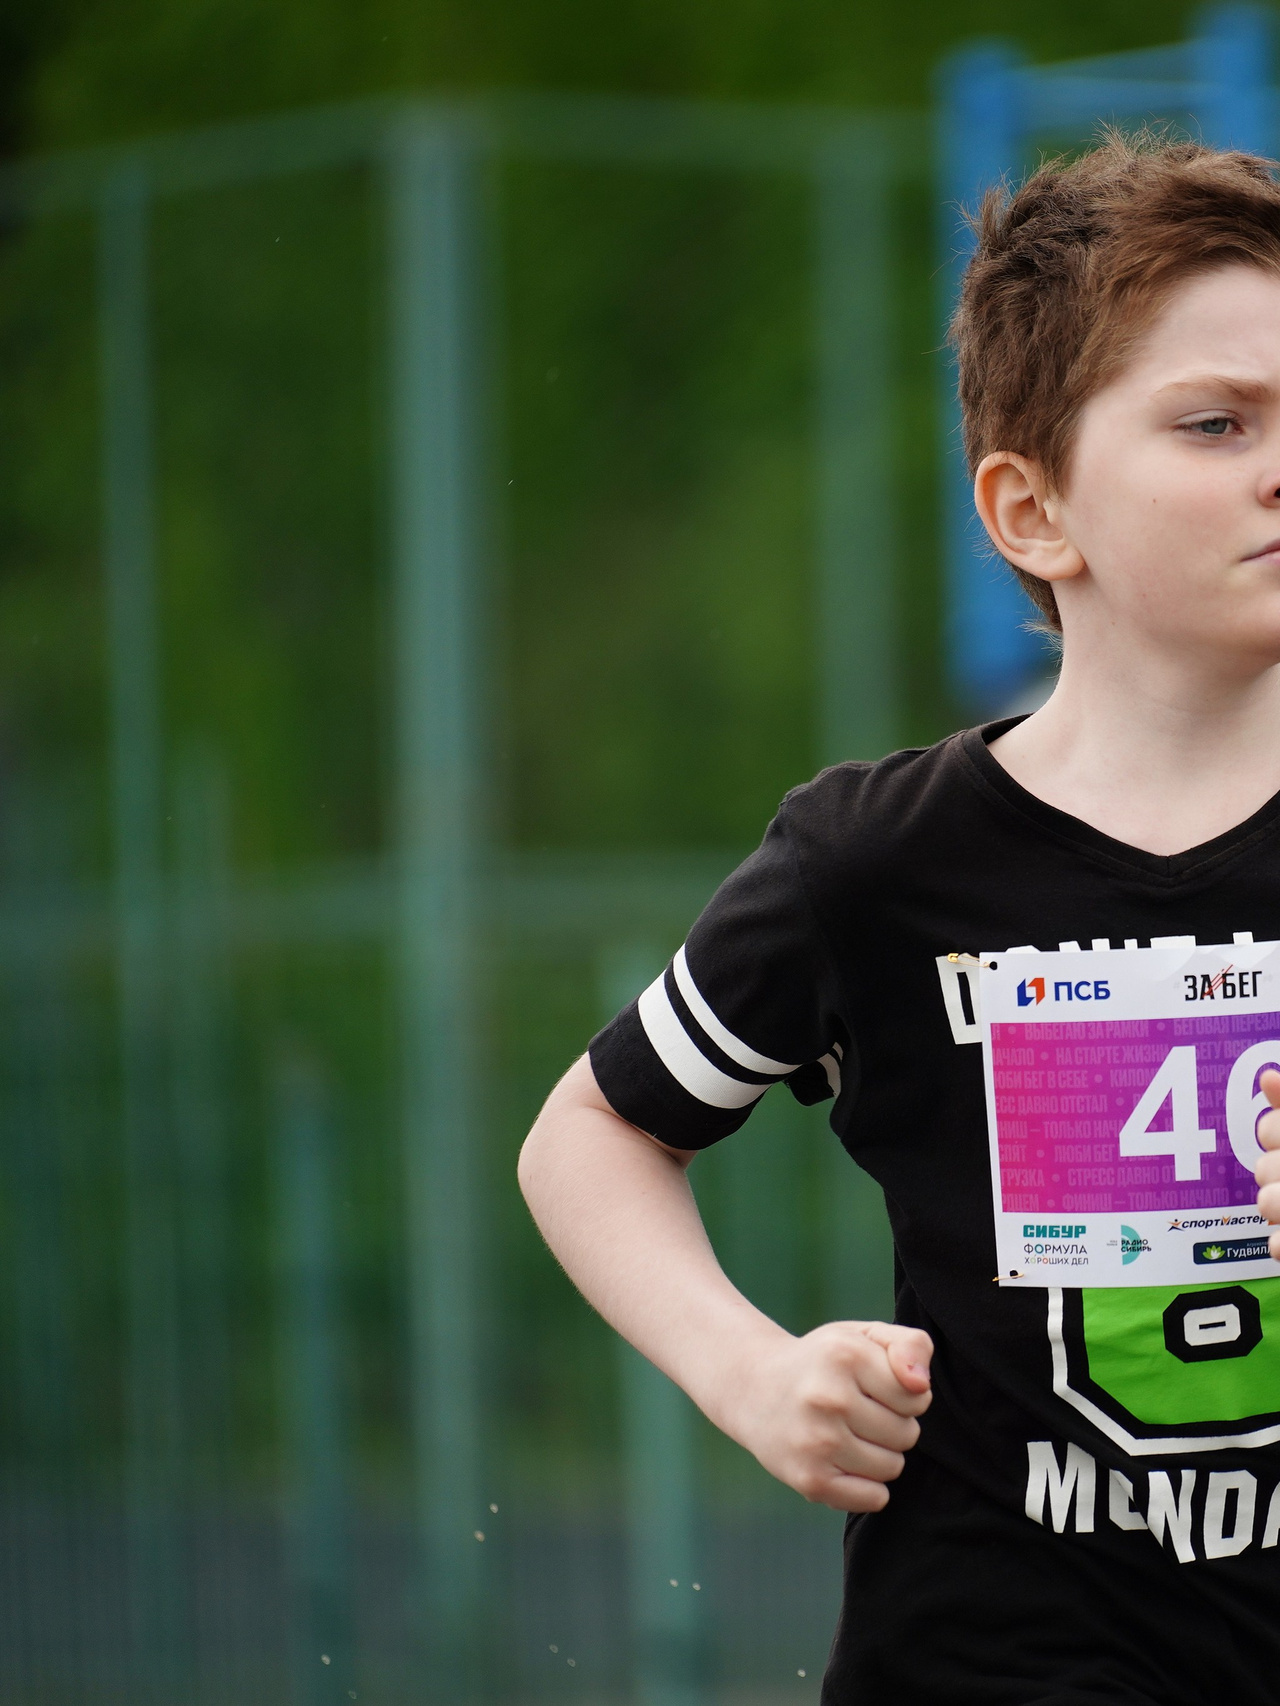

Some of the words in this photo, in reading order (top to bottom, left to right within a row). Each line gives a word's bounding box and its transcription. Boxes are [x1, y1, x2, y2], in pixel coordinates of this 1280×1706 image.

[1054, 980, 1111, 1002] ПСБ
[1056, 1047, 1073, 1066] НА
[1074, 1045, 1120, 1065] СТАРТЕ
[1023, 1070, 1045, 1089] БЕГ
[1057, 1070, 1089, 1088] СЕБЕ
[1017, 1095, 1059, 1115] ДАВНО
[1060, 1094, 1108, 1113] ОТСТАЛ
[1067, 1168, 1115, 1187] СТРЕСС
[1117, 1166, 1160, 1188] ДАВНО
[1023, 1225, 1086, 1238] СИБУР
[1024, 1243, 1088, 1255] ФОРМУЛА
[1121, 1238, 1149, 1246] РАДИО
[1024, 1256, 1070, 1265] ХОРОШИХ
[1071, 1257, 1089, 1266] ДЕЛ
